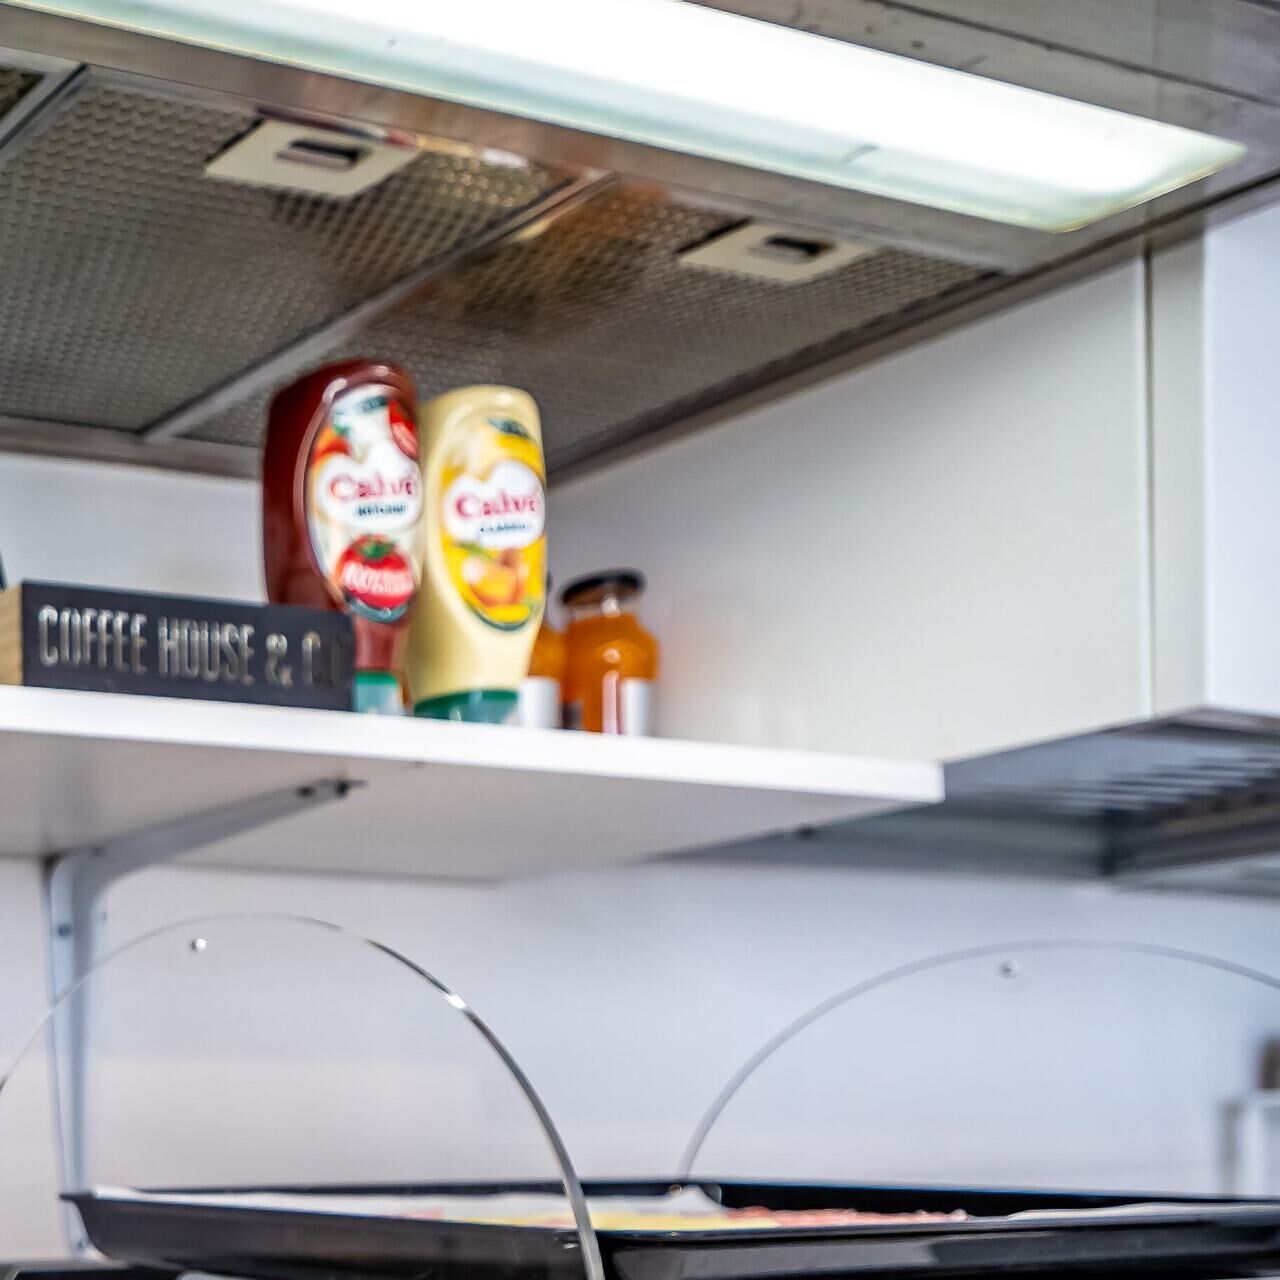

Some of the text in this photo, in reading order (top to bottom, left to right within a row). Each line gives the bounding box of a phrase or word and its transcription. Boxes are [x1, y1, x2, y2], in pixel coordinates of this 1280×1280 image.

[38, 604, 148, 675] COFFEE
[157, 615, 255, 686] HOUSE
[265, 632, 294, 689] &
